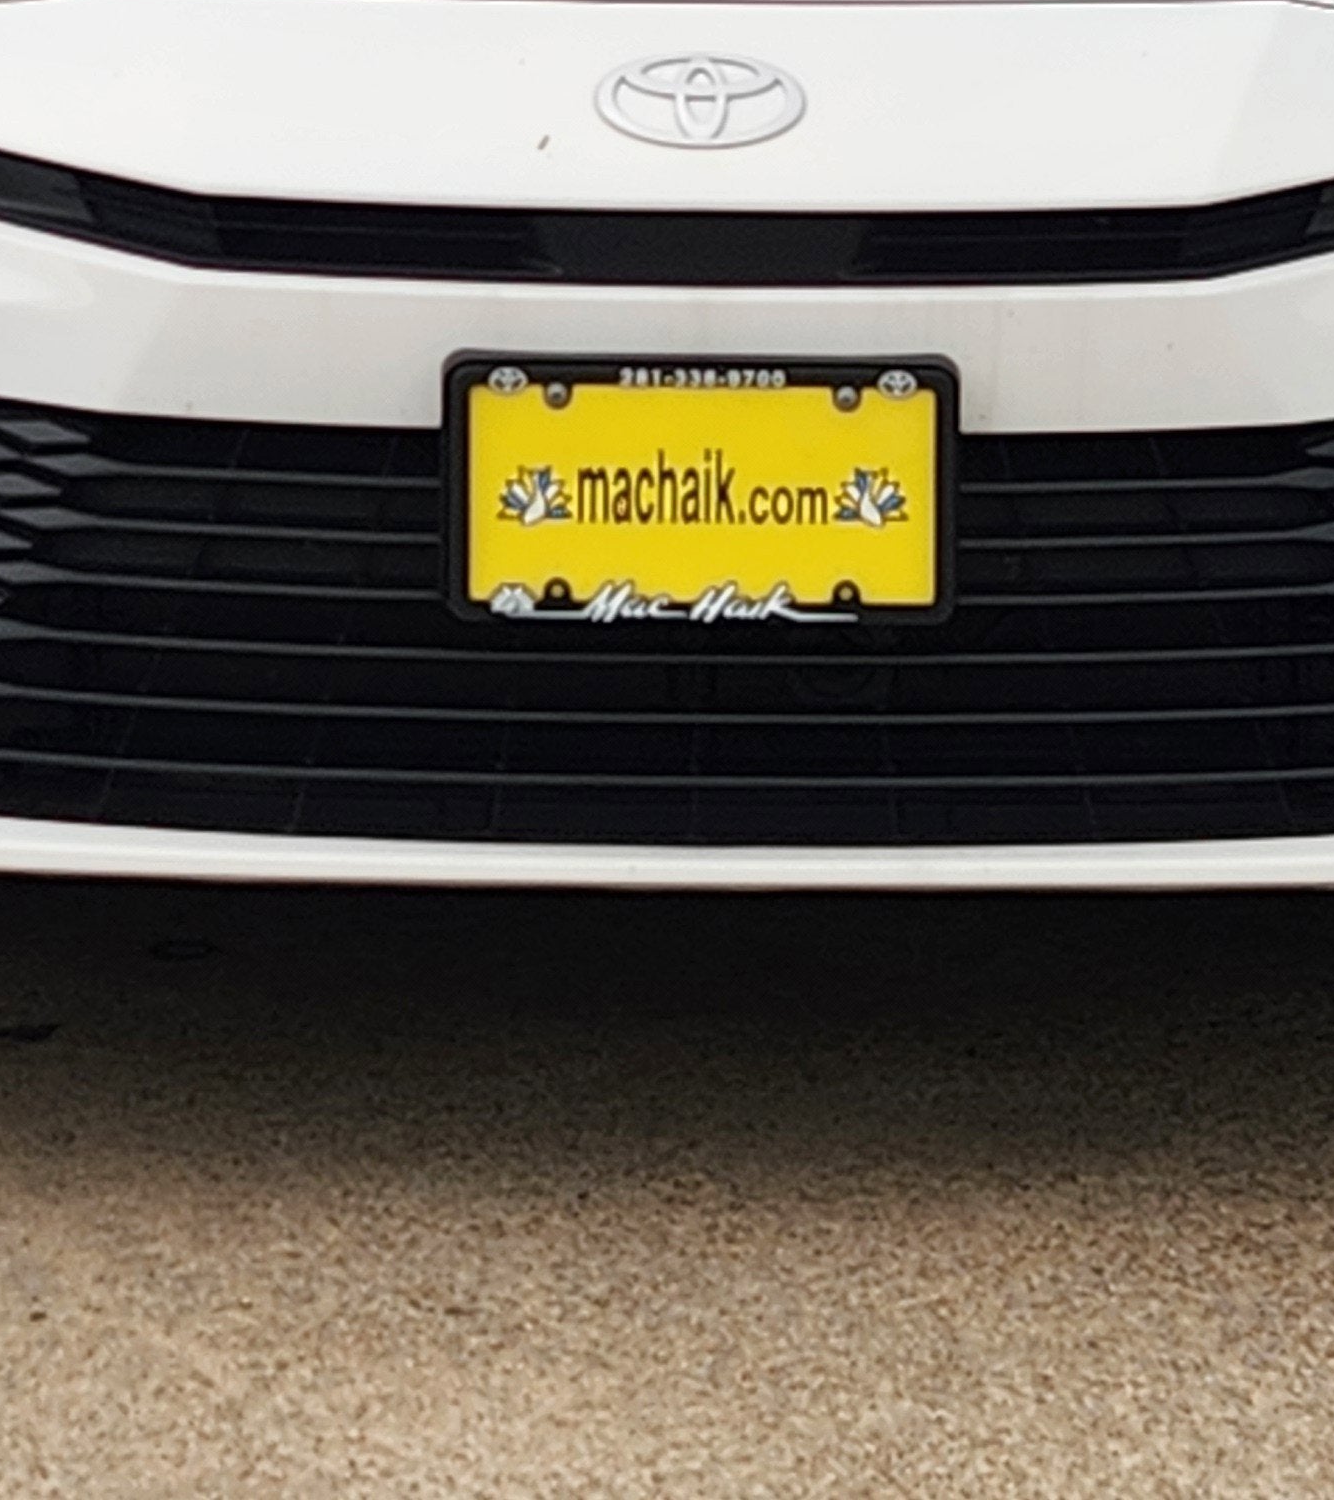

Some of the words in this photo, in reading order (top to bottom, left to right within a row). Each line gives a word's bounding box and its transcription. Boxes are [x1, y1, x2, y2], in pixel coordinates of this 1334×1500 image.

[576, 449, 828, 526] machaik.com
[587, 580, 684, 623] Mac
[689, 582, 799, 623] Haik
